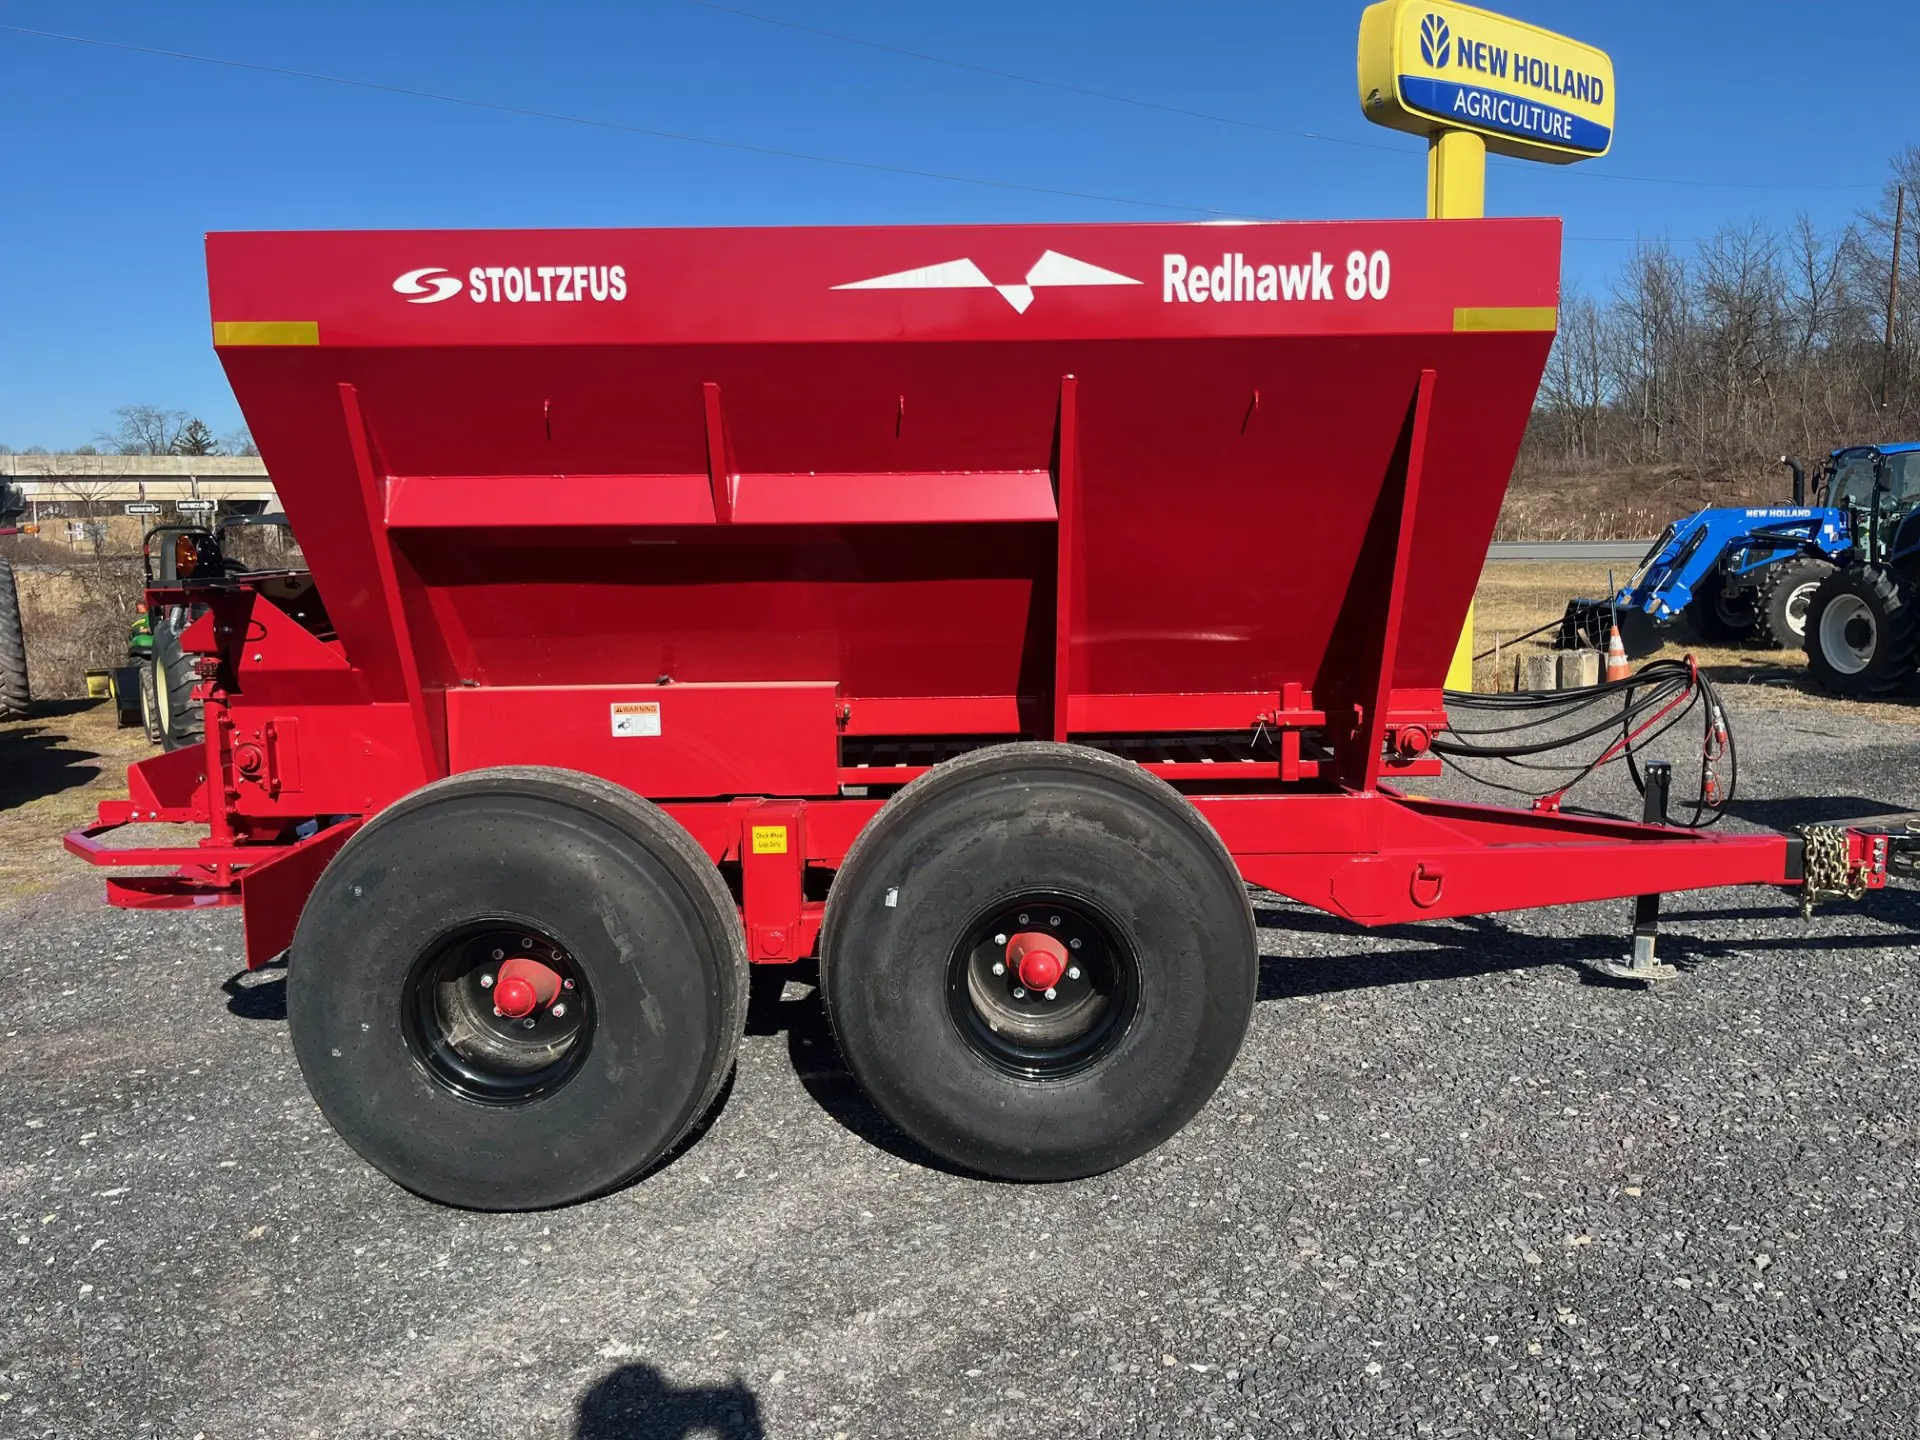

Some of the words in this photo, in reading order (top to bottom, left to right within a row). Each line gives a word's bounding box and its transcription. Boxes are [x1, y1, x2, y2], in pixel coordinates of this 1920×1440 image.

[1457, 36, 1508, 78] NEW
[1513, 53, 1604, 105] HOLLAND
[1453, 88, 1572, 139] AGRICULTURE
[469, 265, 627, 303] STOLTZFUS
[1163, 251, 1334, 303] Redhawk
[1345, 250, 1390, 300] 80
[1746, 509, 1768, 518] NEW
[1769, 509, 1811, 518] HOLLAND
